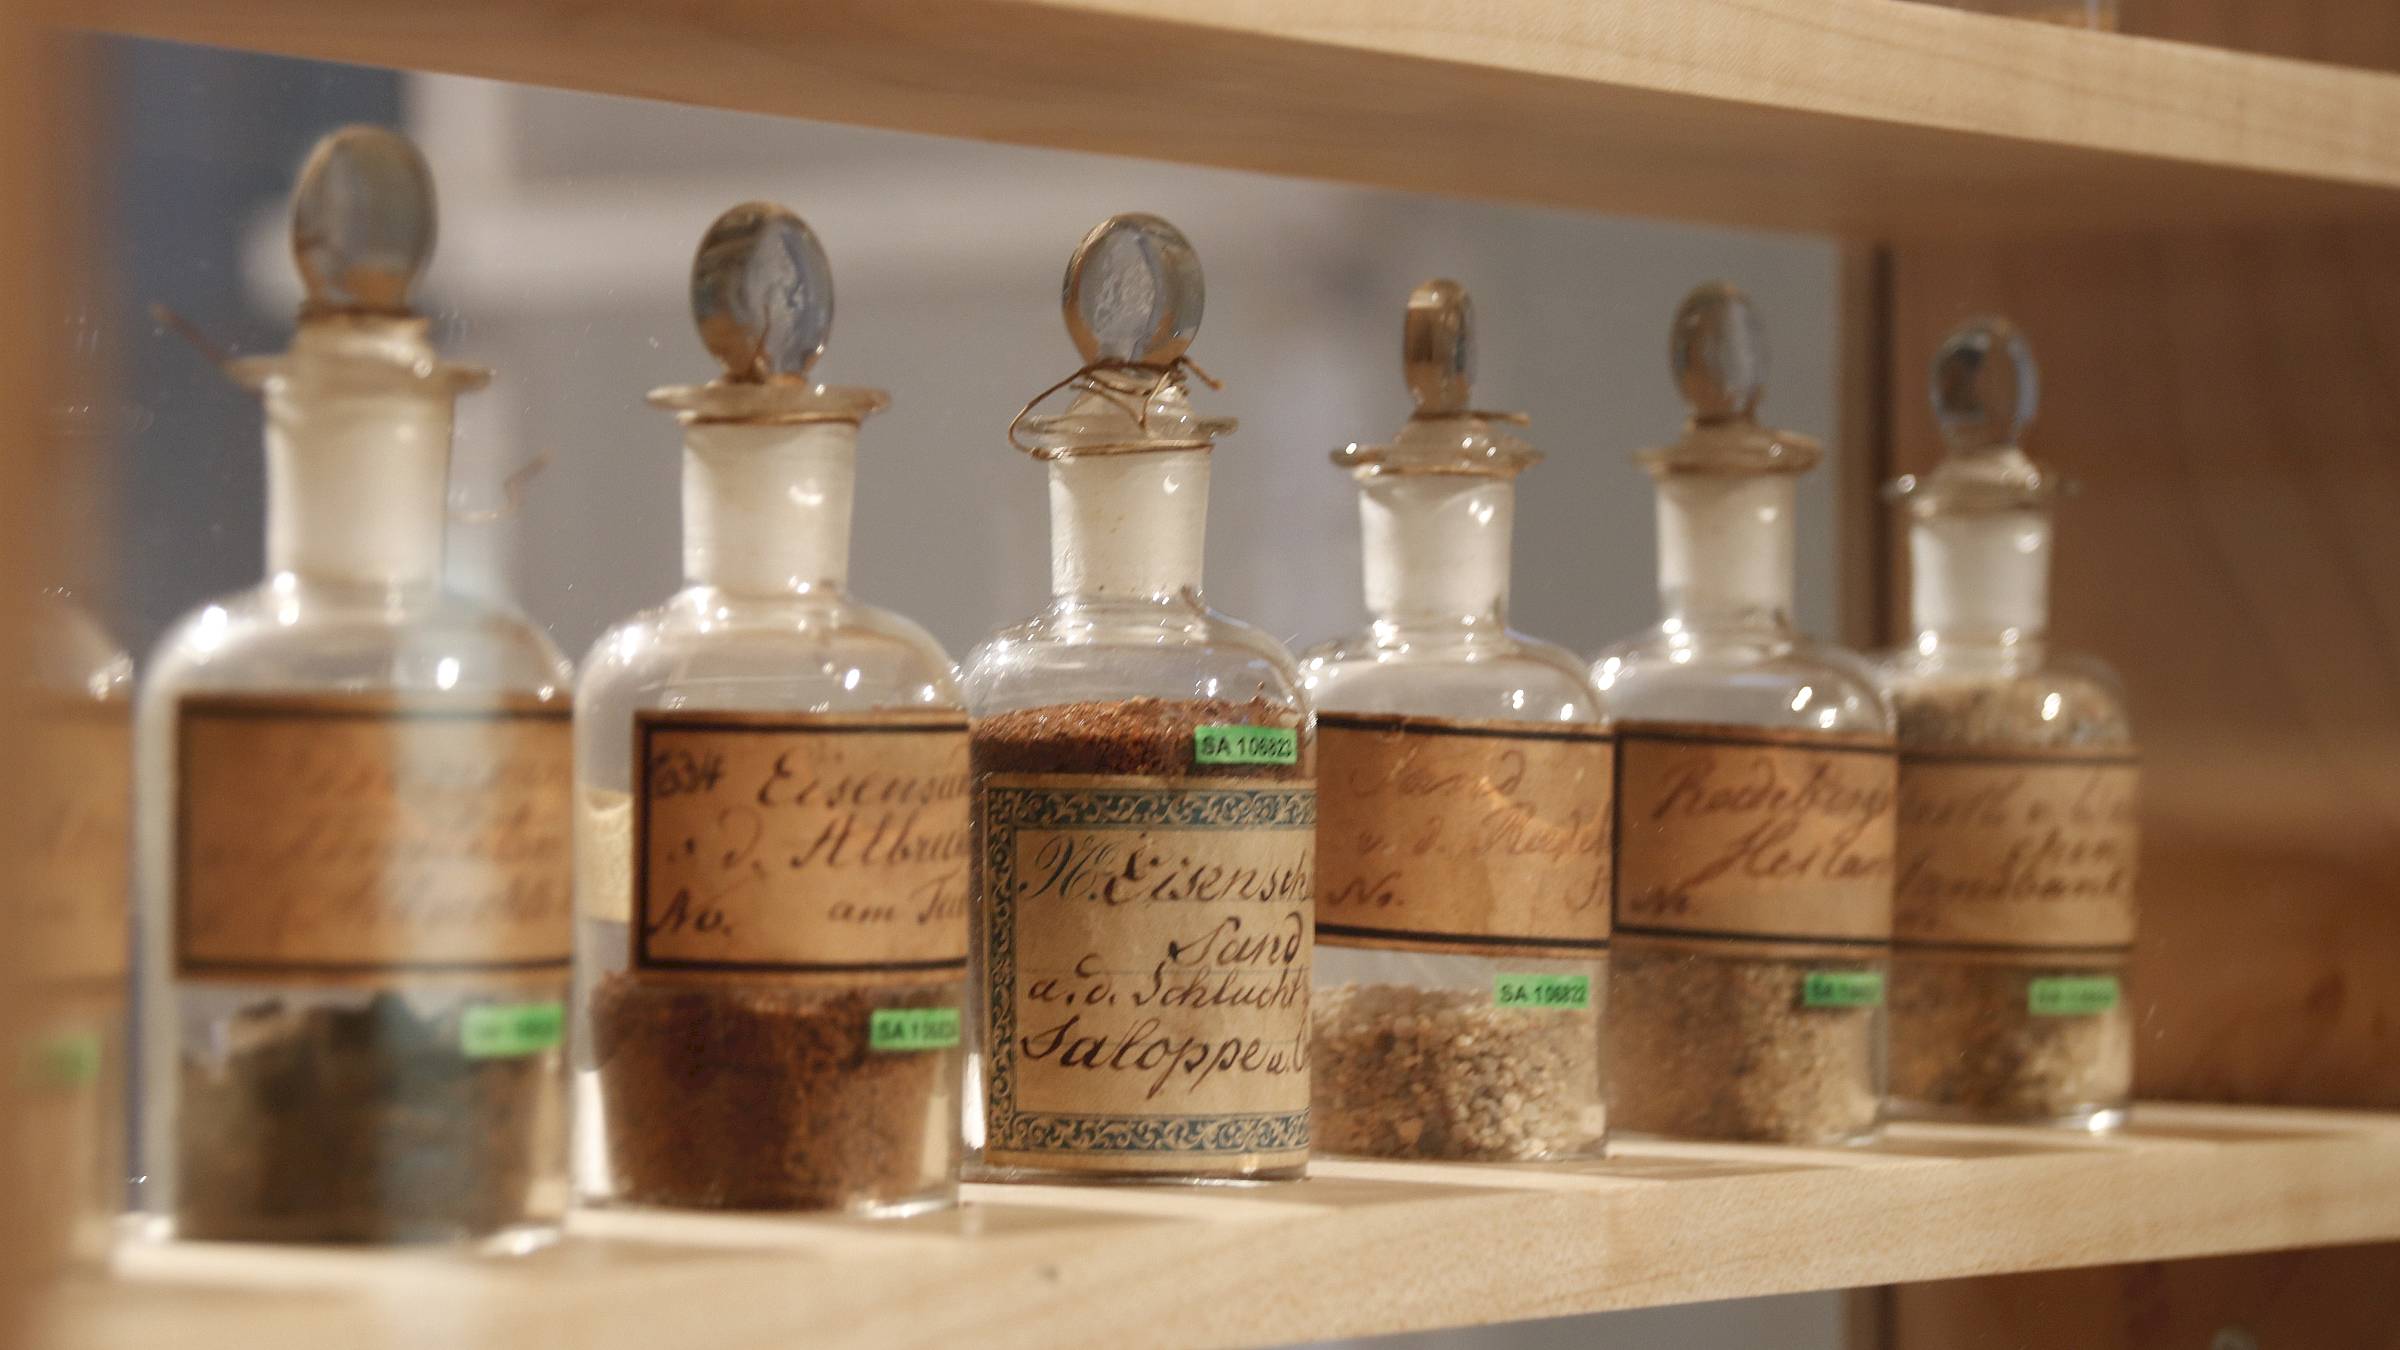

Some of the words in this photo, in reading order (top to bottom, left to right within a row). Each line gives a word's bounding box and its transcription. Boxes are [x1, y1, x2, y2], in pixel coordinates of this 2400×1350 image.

[1200, 734, 1232, 757] SA
[1103, 834, 1314, 906] Eisensch
[1167, 910, 1304, 970] Sand
[1132, 960, 1312, 1010] Schlucht
[1500, 984, 1528, 1004] SA
